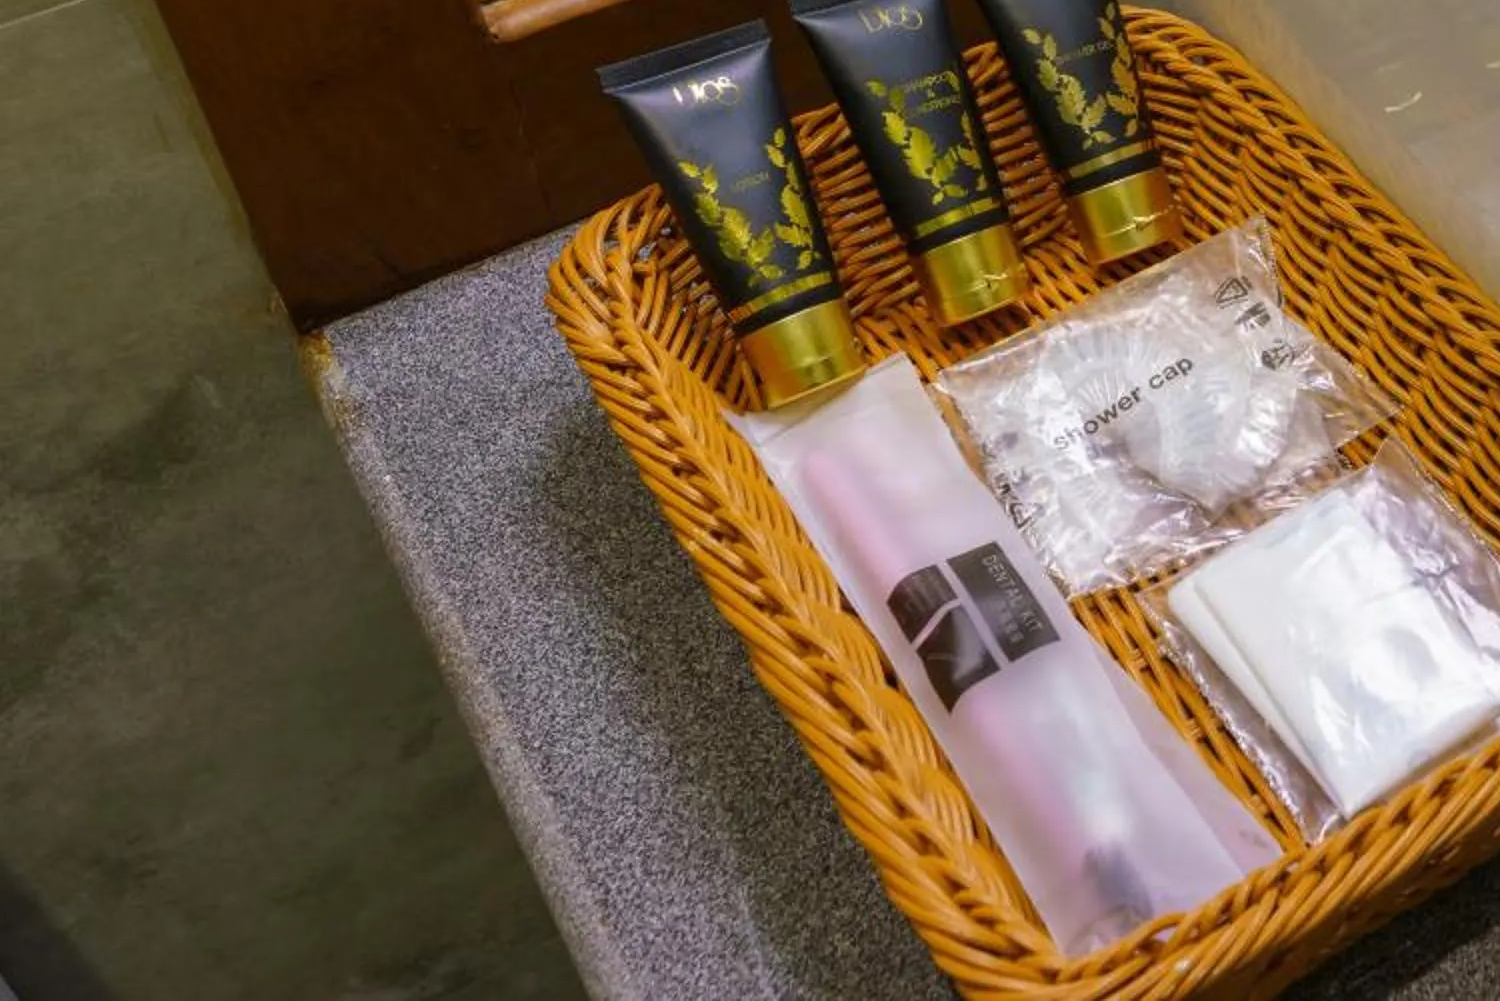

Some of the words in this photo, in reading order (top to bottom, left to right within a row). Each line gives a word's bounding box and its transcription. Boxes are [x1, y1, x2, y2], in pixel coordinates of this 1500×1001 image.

[1053, 387, 1141, 450] shower
[1149, 358, 1194, 390] cap
[981, 554, 1026, 608] DENTAL
